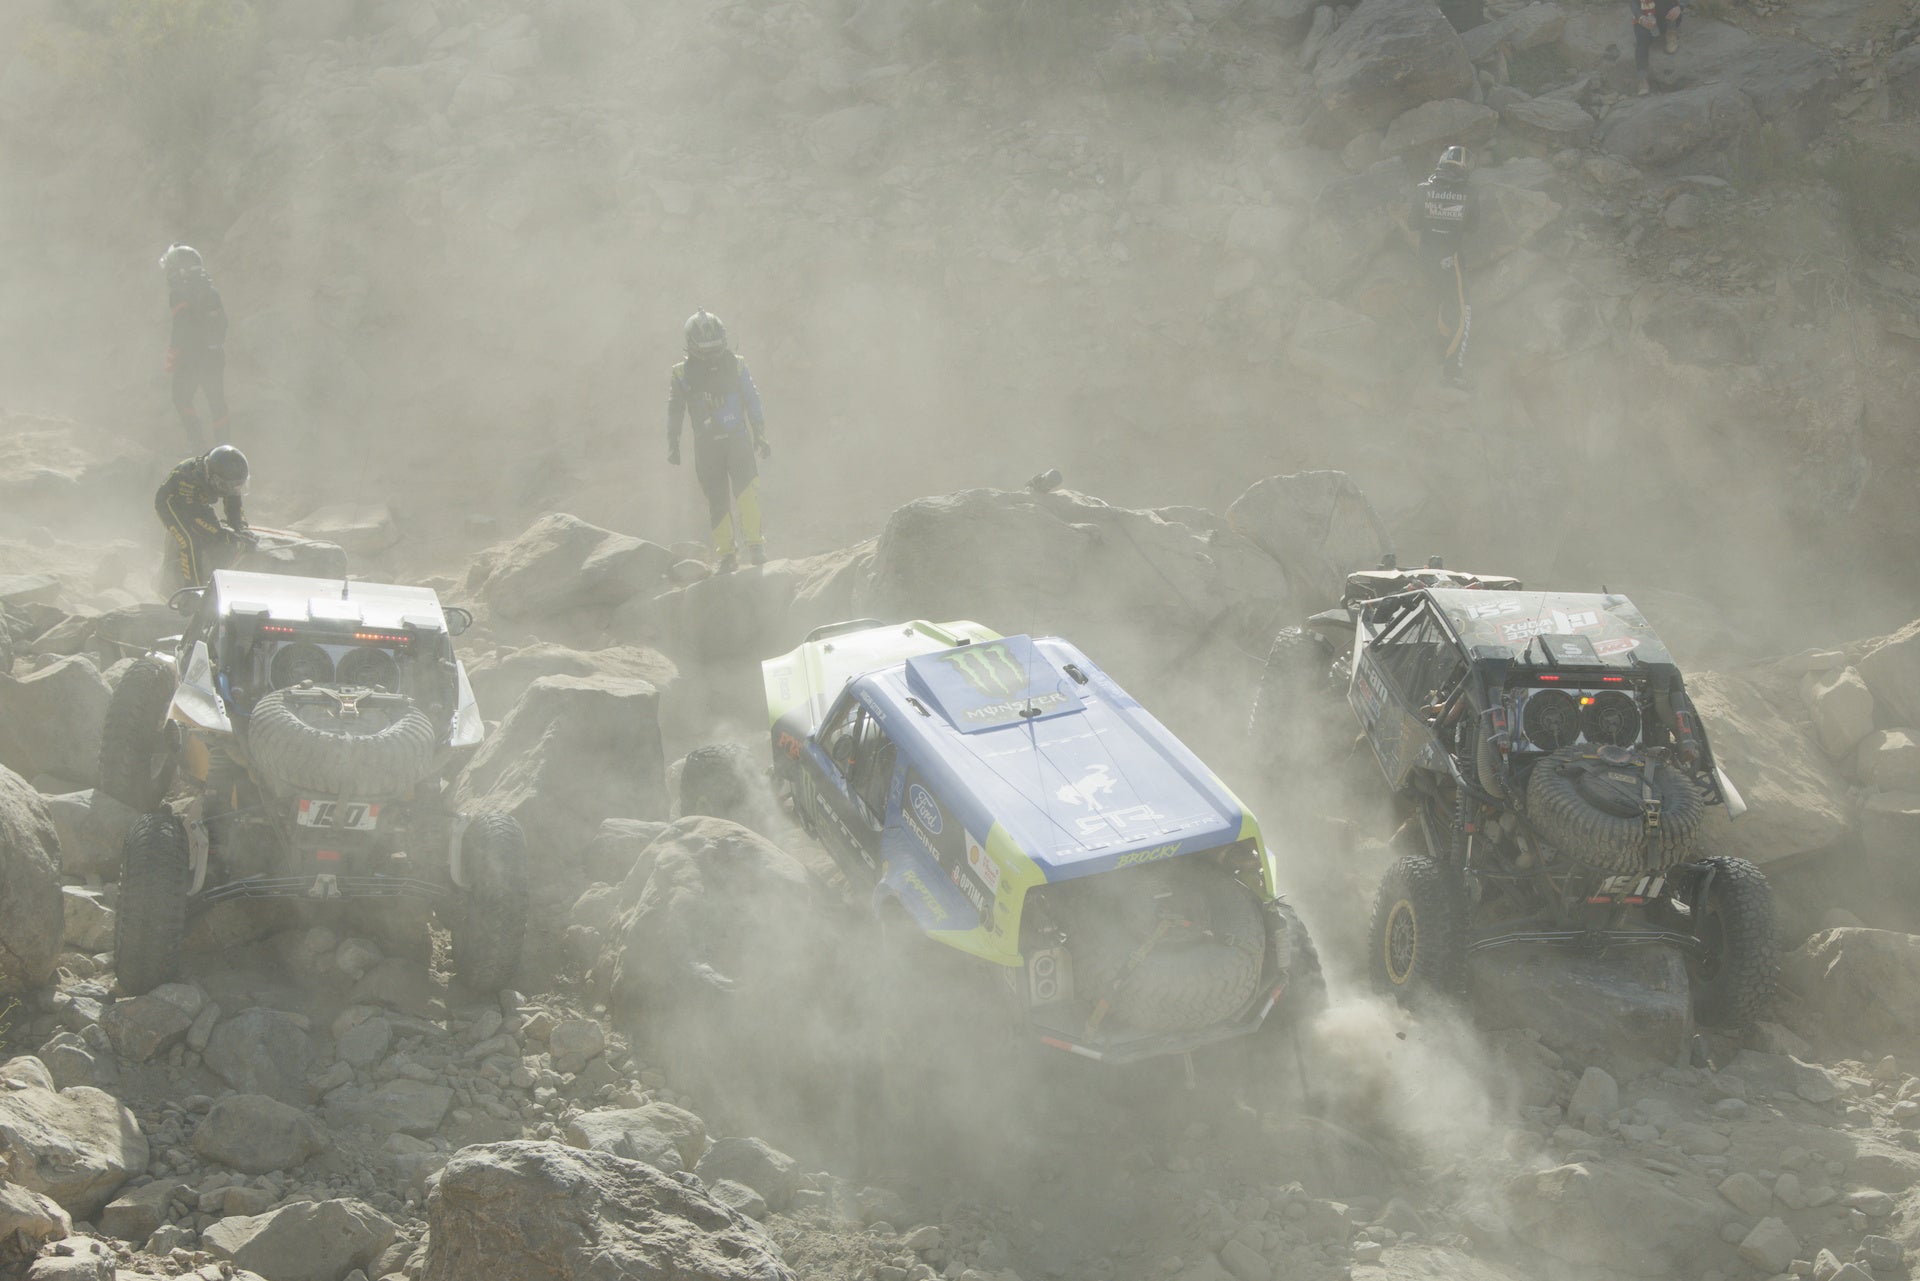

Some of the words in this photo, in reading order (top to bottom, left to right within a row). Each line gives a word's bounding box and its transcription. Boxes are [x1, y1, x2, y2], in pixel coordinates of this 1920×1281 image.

[967, 693, 1066, 719] MONSTER
[902, 808, 940, 862] RACING
[1115, 842, 1182, 869] BROCKY
[959, 874, 985, 912] OPTIMA
